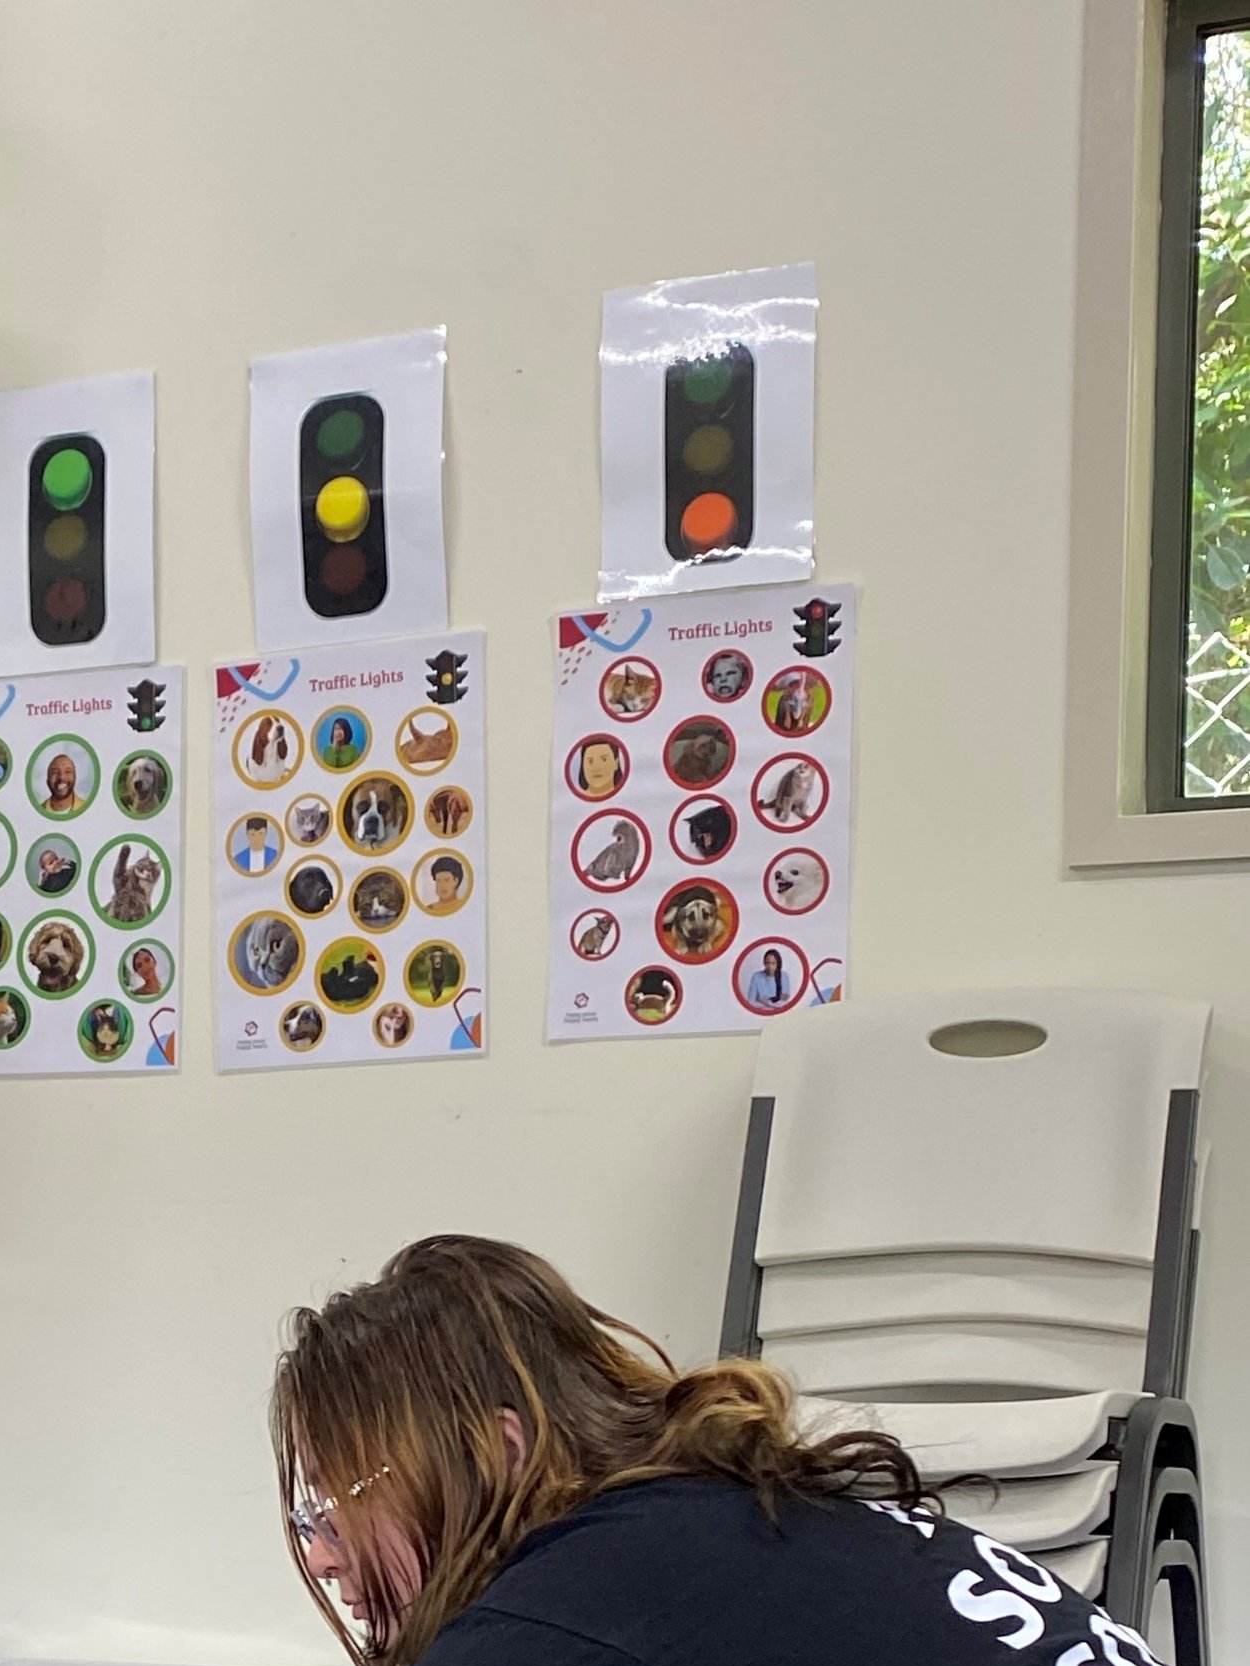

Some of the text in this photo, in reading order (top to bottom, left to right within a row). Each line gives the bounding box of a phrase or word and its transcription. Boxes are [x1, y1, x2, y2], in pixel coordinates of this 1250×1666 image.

[668, 619, 773, 641] Traffic Lights
[309, 670, 404, 692] Traffic Lights
[26, 698, 112, 717] Traffic Lights
